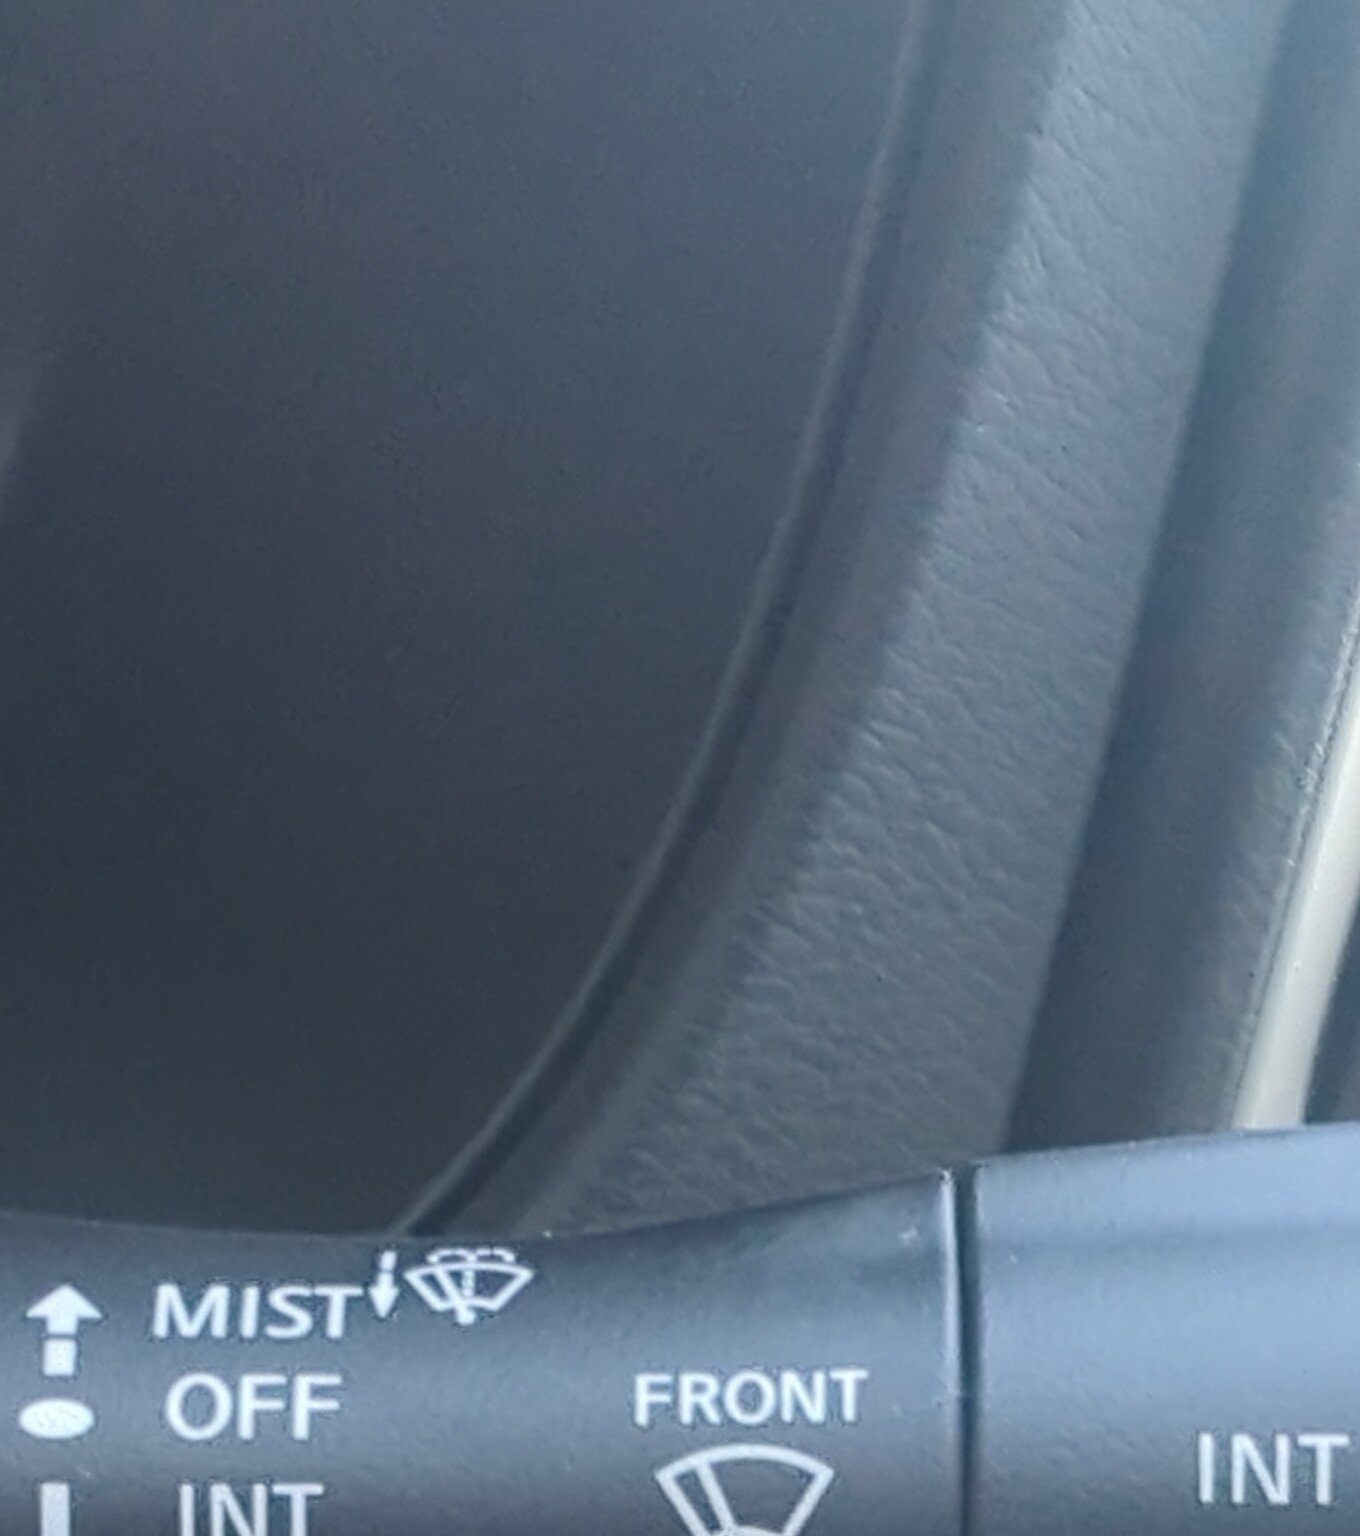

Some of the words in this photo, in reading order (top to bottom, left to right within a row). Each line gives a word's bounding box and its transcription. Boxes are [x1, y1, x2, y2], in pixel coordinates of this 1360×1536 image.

[151, 1282, 364, 1340] MIST
[164, 1371, 344, 1442] OFF
[633, 1367, 870, 1428] FRONT
[1197, 1430, 1351, 1506] INT
